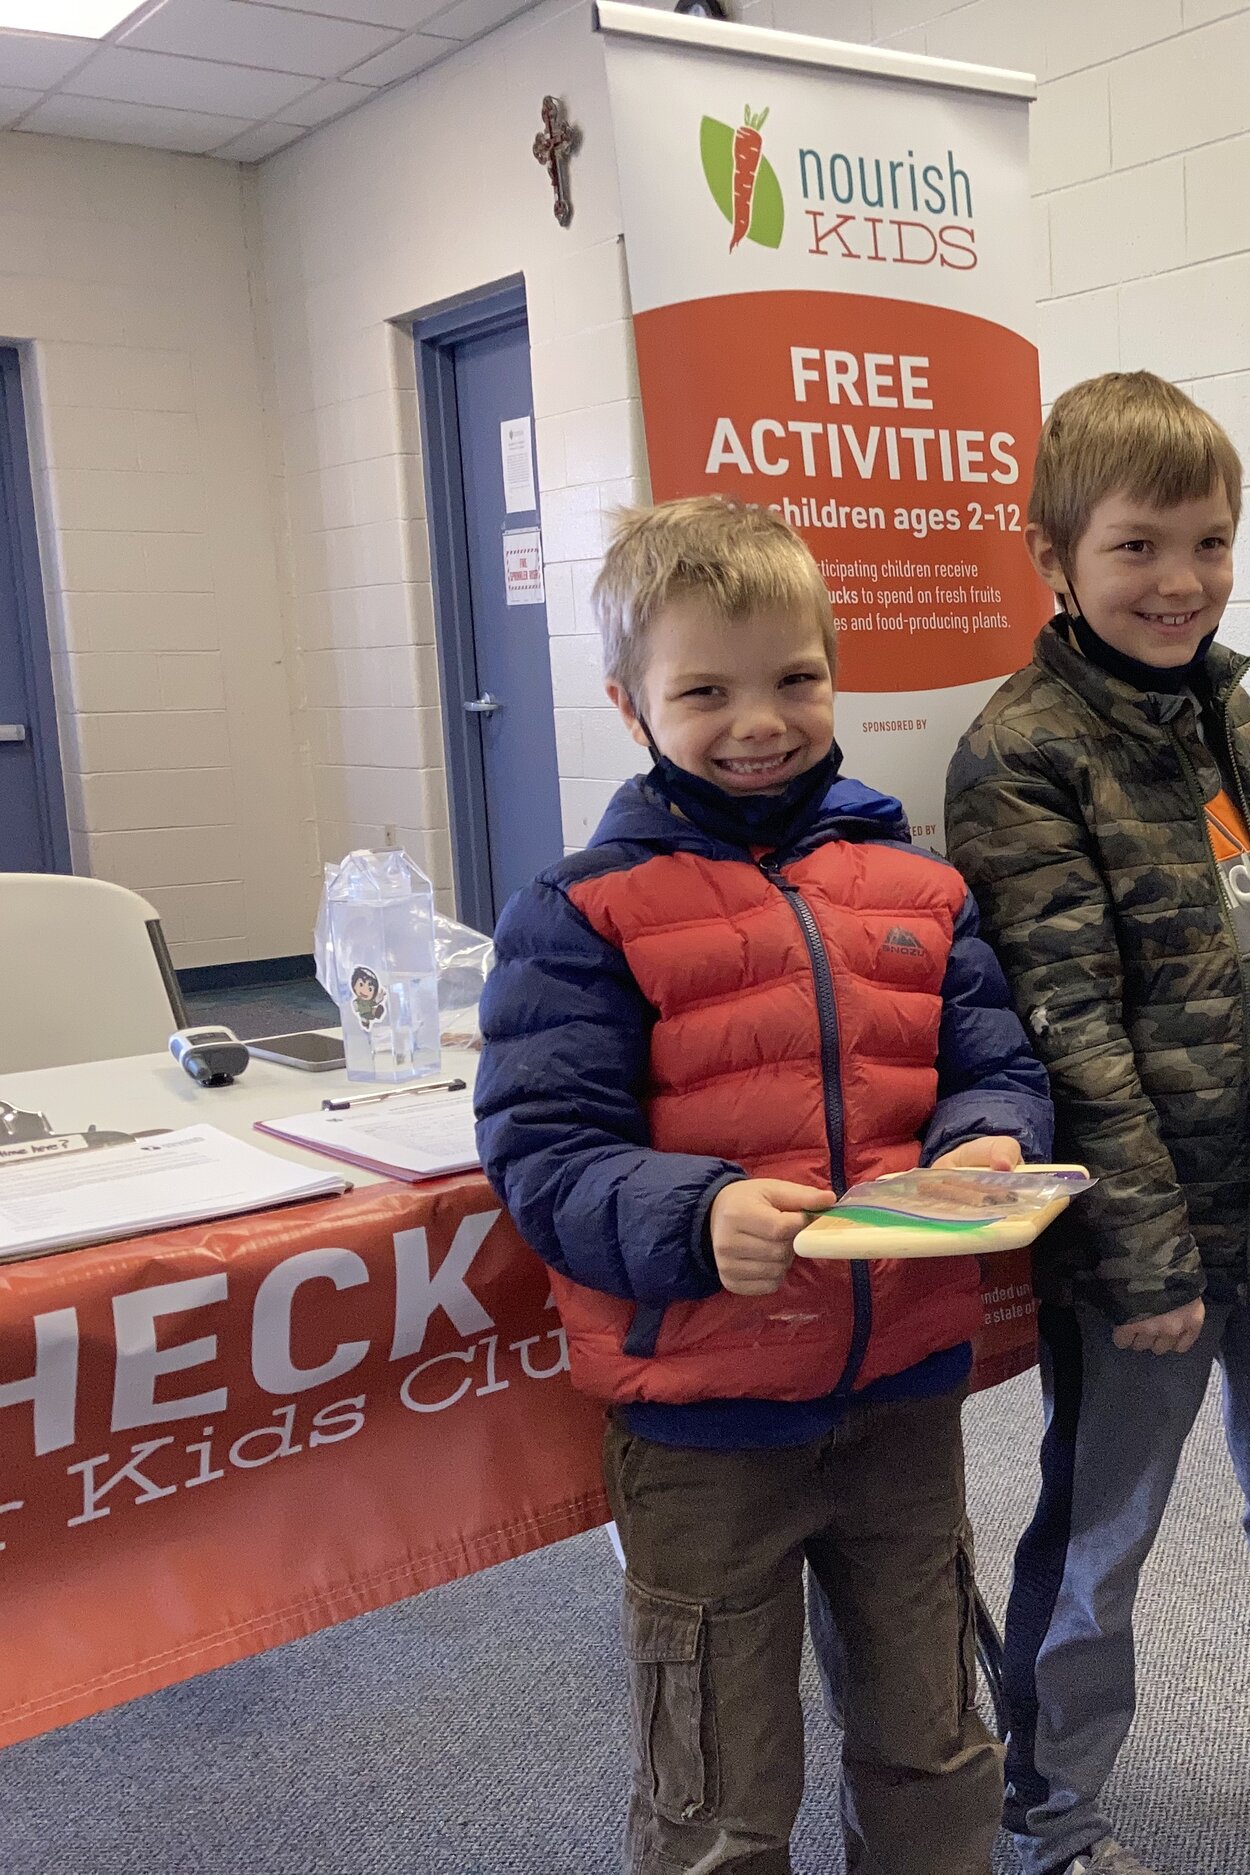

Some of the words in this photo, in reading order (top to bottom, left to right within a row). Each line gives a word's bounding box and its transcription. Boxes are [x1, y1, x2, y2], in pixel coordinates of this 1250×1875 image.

[798, 148, 973, 218] nourish
[805, 209, 978, 271] KIDS
[790, 346, 934, 410] FREE
[704, 417, 1020, 485] ACTIVITIES
[893, 507, 961, 539] ages
[967, 502, 1022, 532] 2-12
[881, 559, 931, 578] children
[934, 560, 978, 577] receive
[861, 587, 874, 604] to
[877, 586, 914, 609] spend
[917, 590, 932, 604] on
[935, 585, 967, 604] fresh
[970, 585, 1001, 603] fruits
[833, 617, 848, 631] es
[851, 612, 873, 631] and
[876, 611, 969, 635] food-producing
[972, 611, 1011, 633] plants.
[862, 720, 914, 733] SPONSORED
[916, 719, 927, 730] BY
[909, 825, 923, 837] ED
[925, 824, 936, 836] BY
[993, 1303, 1023, 1324] state
[66, 1394, 366, 1528] Kids
